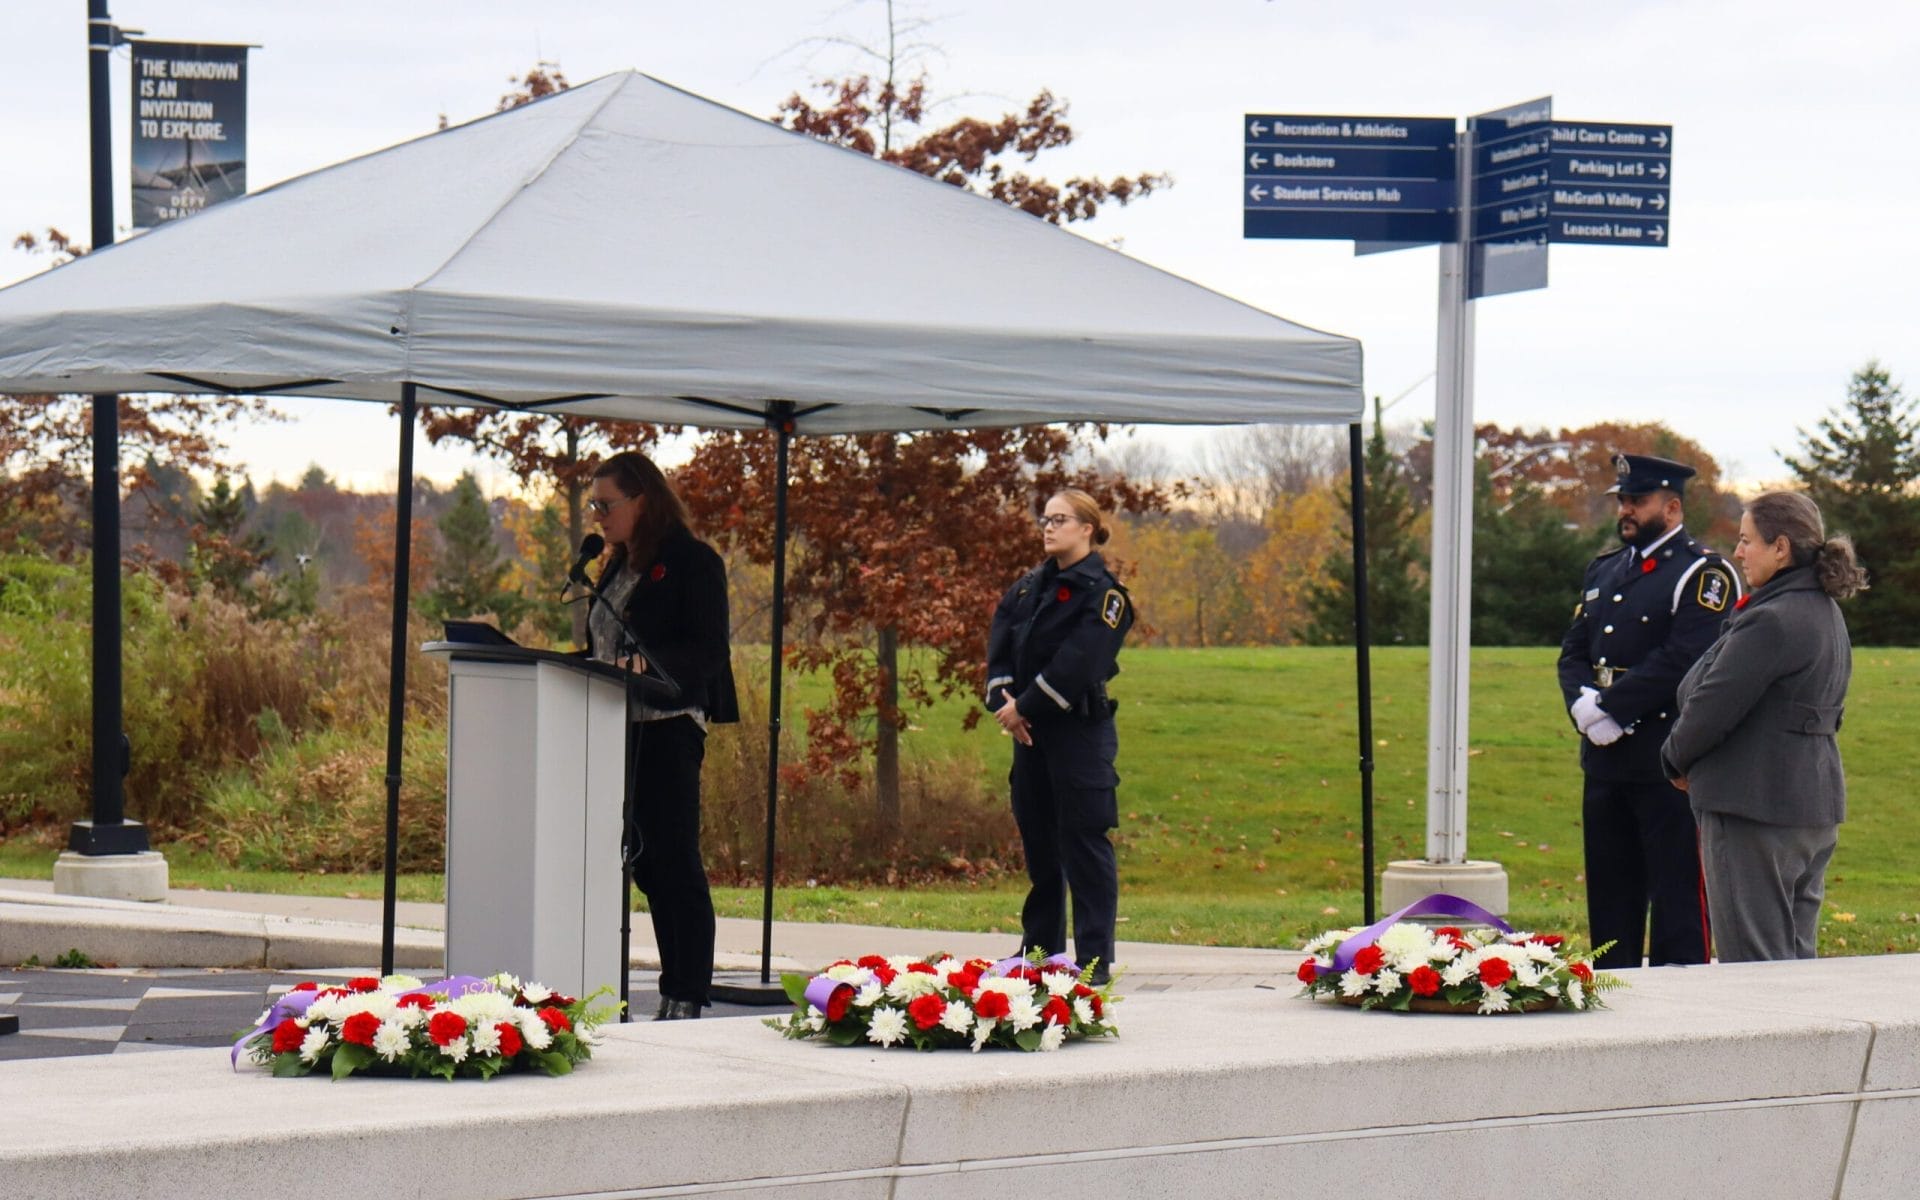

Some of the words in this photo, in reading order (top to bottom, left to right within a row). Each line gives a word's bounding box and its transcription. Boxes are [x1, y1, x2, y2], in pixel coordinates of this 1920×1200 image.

[141, 59, 168, 78] THE
[170, 60, 239, 80] UNKNOWN
[140, 79, 155, 97] IS
[157, 80, 178, 98] AN
[140, 100, 214, 120] INVITATION
[140, 120, 158, 138] TO
[162, 121, 227, 141] EXPLORE.
[1273, 121, 1339, 136] Recreation
[1341, 122, 1352, 137] &
[1353, 123, 1408, 138] Athletics
[1578, 128, 1606, 143] Care
[1607, 129, 1646, 145] Centre
[1273, 153, 1335, 168] Bookstore
[1569, 159, 1615, 178] Parking
[1616, 161, 1635, 175] Lot
[171, 195, 205, 207] DEFY
[1273, 185, 1320, 200] Student
[1321, 187, 1374, 202] Services
[1376, 188, 1401, 202] Hub
[1606, 192, 1643, 210] Valley
[1563, 222, 1612, 236] Leacock
[1614, 223, 1642, 238] Lane
